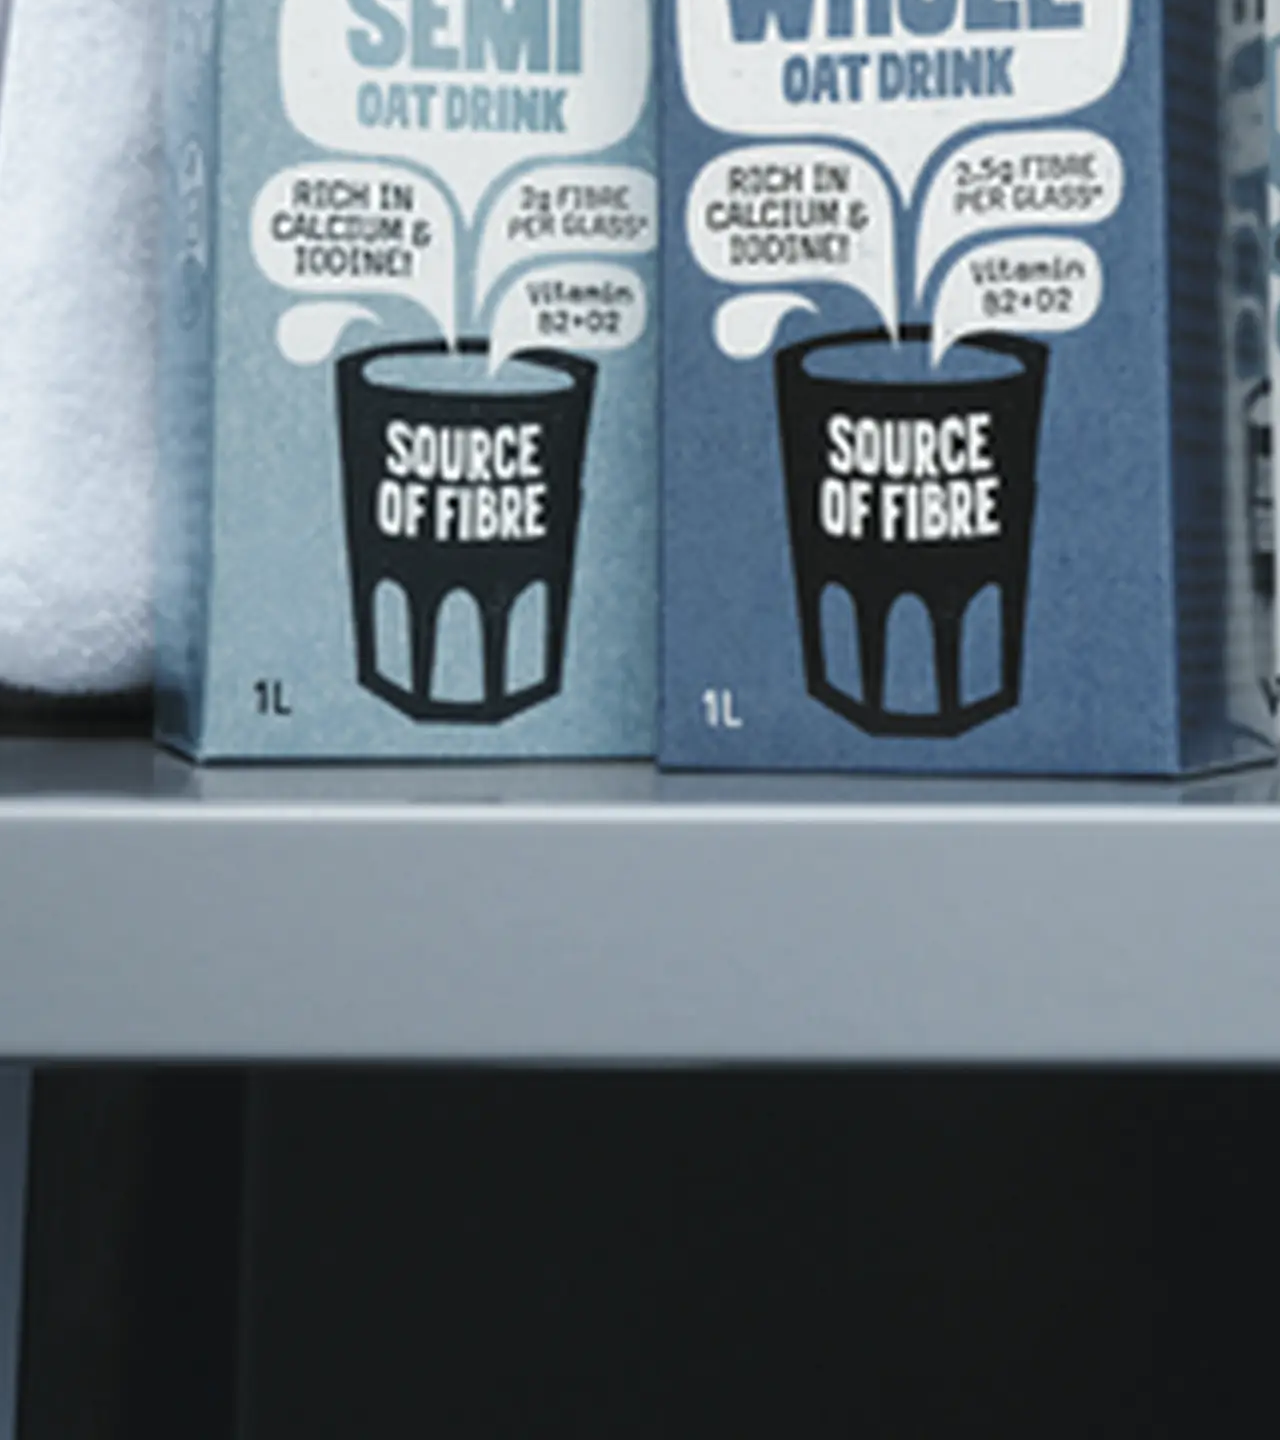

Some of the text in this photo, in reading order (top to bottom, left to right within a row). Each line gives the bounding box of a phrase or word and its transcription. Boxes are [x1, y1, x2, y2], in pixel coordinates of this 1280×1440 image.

[783, 46, 1015, 105] OAT DRINK
[356, 81, 568, 133] OAT DRINK
[292, 179, 414, 212] RICH IN
[728, 162, 850, 194] RICH IN
[705, 198, 870, 233] CALCIUM &
[954, 186, 1006, 214] PER
[271, 210, 404, 241] CALCIUM
[385, 420, 543, 481] SOURCE
[827, 412, 993, 478] SOURCE
[377, 480, 548, 541] OF FIBRE
[821, 477, 1001, 541] OF FIBRE
[254, 680, 292, 716] 1L
[702, 688, 743, 728] 1L
